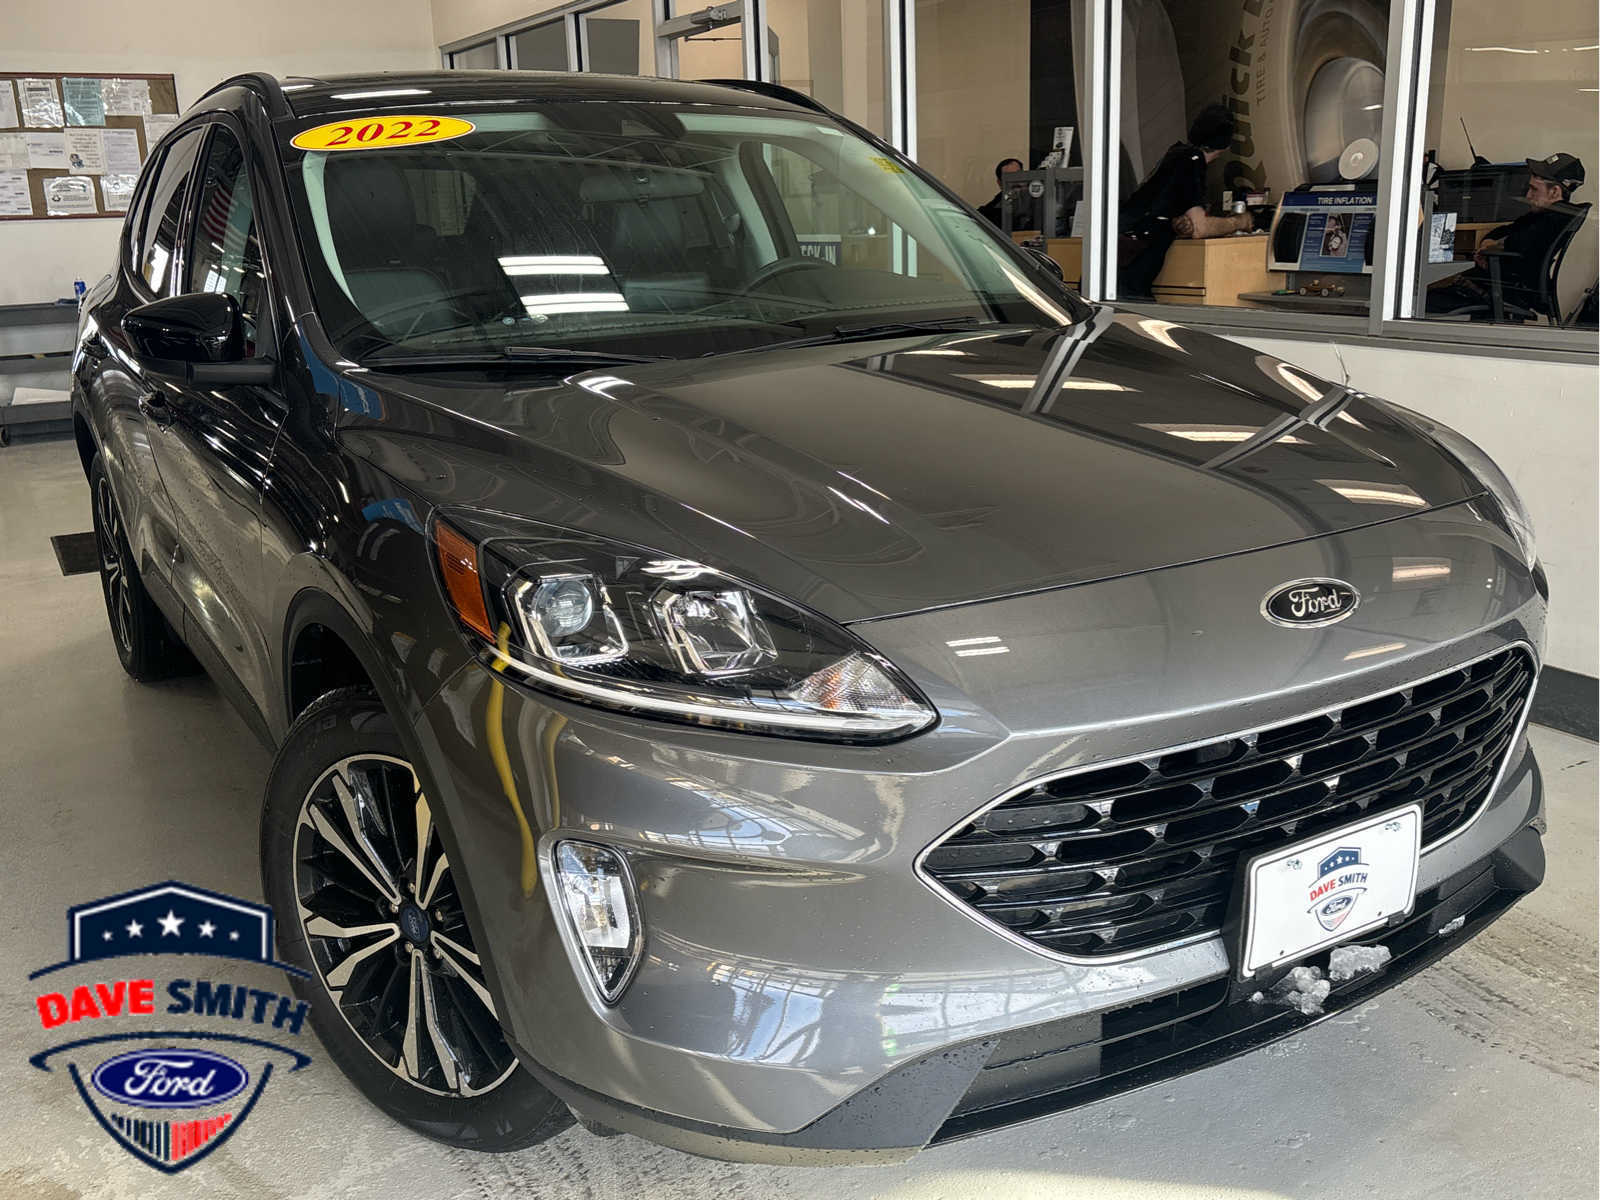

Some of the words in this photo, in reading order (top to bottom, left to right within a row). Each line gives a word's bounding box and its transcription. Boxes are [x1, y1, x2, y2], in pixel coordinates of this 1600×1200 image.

[325, 120, 441, 147] 2022
[1317, 197, 1334, 205] TIRE
[1334, 197, 1373, 205] INFLATION
[1289, 586, 1342, 617] Ford
[1310, 879, 1336, 901] DAVE
[1338, 873, 1368, 887] SMITH
